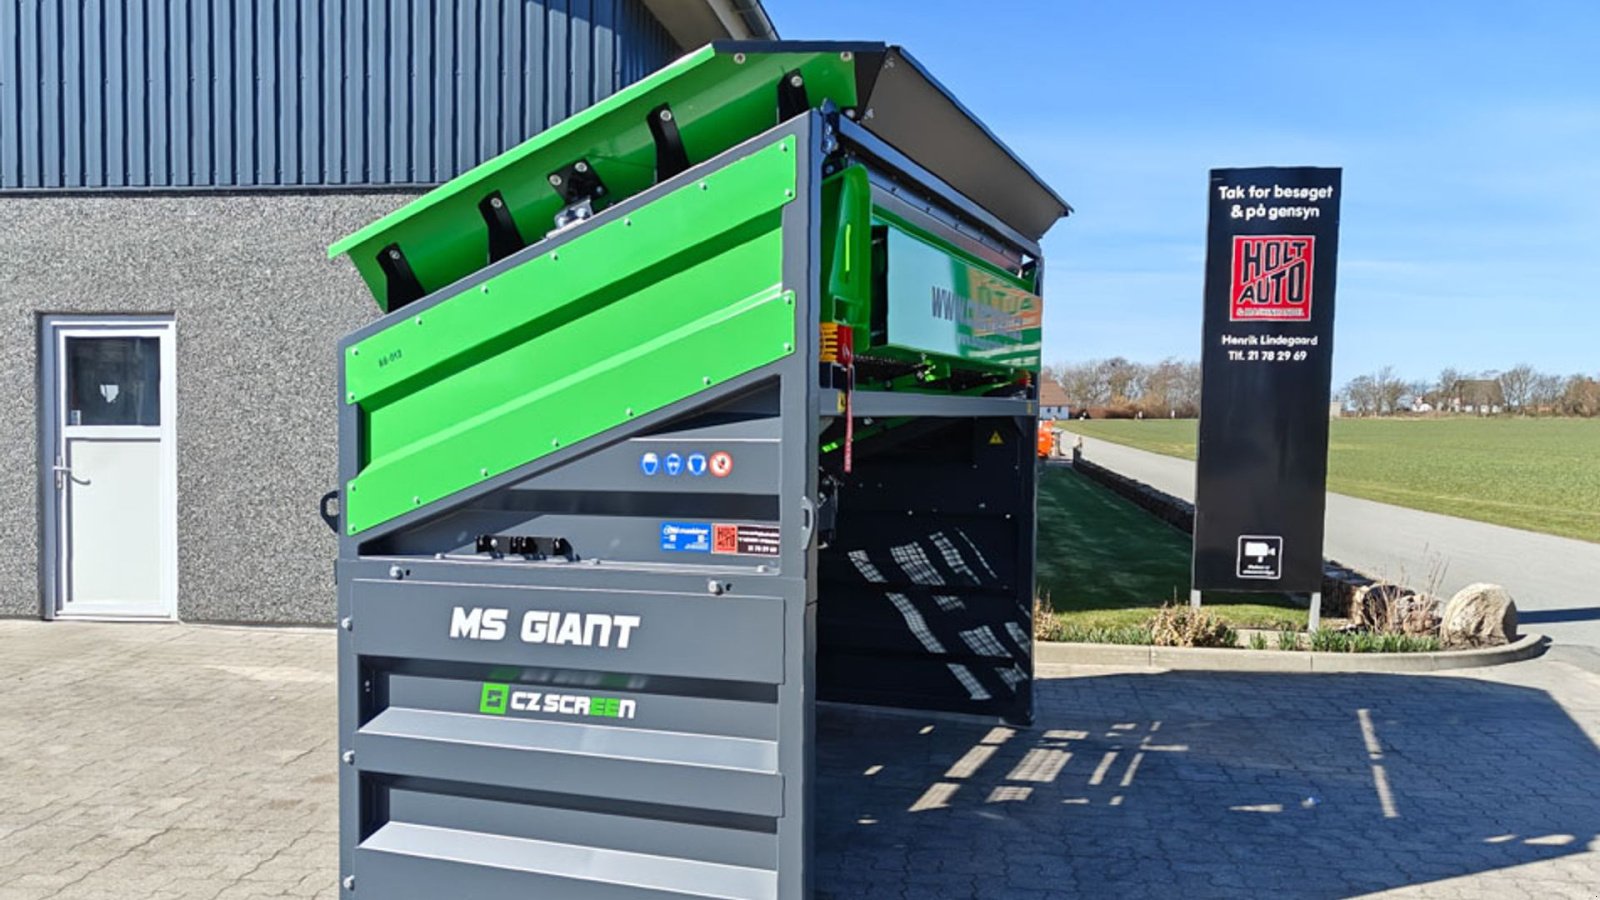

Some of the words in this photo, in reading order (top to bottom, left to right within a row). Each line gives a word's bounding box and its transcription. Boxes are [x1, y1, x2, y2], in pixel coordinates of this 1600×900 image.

[1218, 185, 1245, 199] Tak
[1248, 185, 1271, 198] for
[1274, 184, 1333, 202] besøget
[1231, 204, 1243, 218] &
[1245, 203, 1266, 221] på
[1268, 206, 1320, 221] gensyn
[1241, 240, 1307, 285] HOLT
[1238, 260, 1306, 304] AUTO
[1222, 335, 1258, 345] Henrik
[1260, 335, 1318, 347] Lindegaard
[1228, 350, 1245, 361] Tlf.
[1247, 350, 1259, 361] 21
[1261, 350, 1275, 361] 78
[1277, 350, 1291, 361] 29
[1293, 350, 1307, 361] 69
[450, 606, 509, 640] MS
[521, 610, 641, 649] GIANT
[510, 691, 542, 711] CZ
[543, 695, 636, 719] SCREEN
